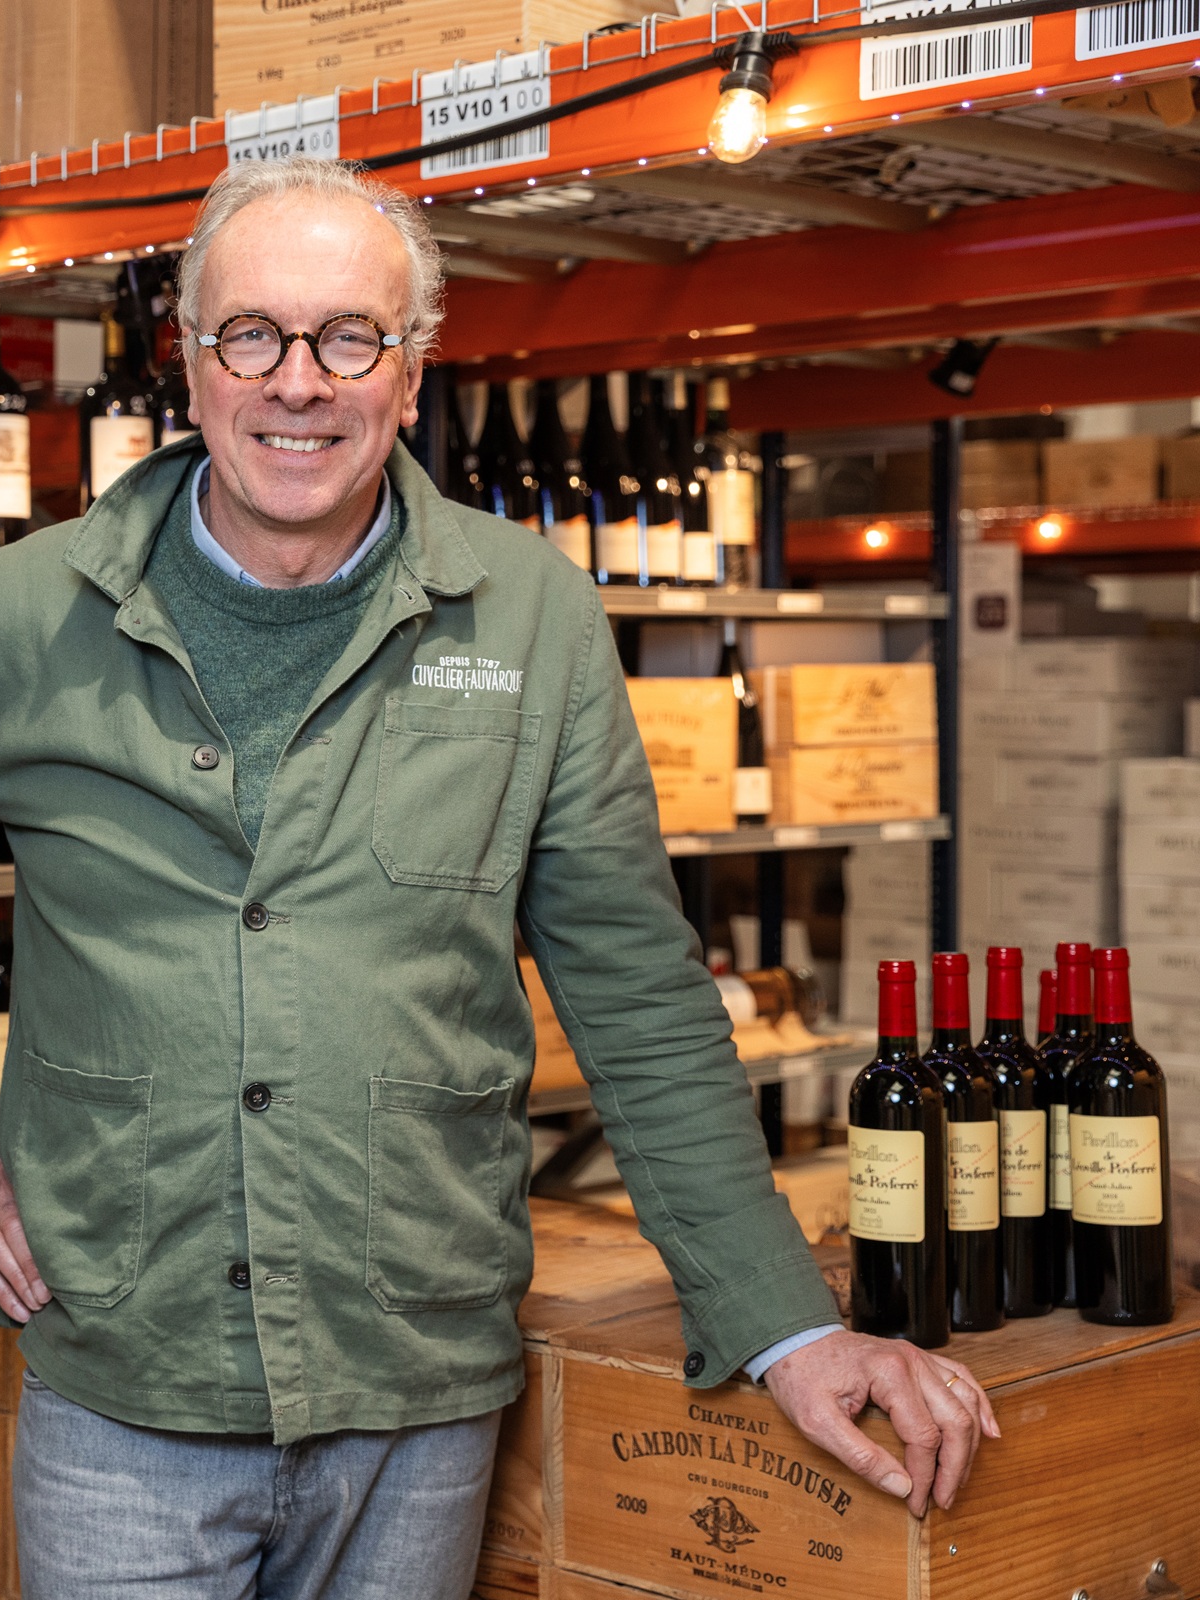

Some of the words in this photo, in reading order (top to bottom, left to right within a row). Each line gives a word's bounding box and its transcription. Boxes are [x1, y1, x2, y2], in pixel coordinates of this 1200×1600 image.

[428, 107, 449, 127] 15
[456, 99, 492, 121] V10
[500, 95, 508, 113] 1
[234, 148, 252, 161] 15
[258, 141, 291, 161] V10
[295, 137, 306, 152] 4
[439, 656, 470, 667] DEPUIS
[476, 657, 500, 670] 1787
[412, 665, 464, 690] CUVELIER
[465, 668, 524, 694] FAUVARQUE
[1016, 1145, 1029, 1156] de
[1081, 1130, 1139, 1149] Pavillon
[850, 1141, 899, 1163] Pavillon
[1103, 1150, 1115, 1161] de
[864, 1163, 876, 1175] de
[953, 1167, 996, 1184] Poyferré
[1109, 1160, 1157, 1179] Poyferré
[869, 1174, 919, 1193] Poyferré
[688, 1404, 770, 1436] CHATEAU
[612, 1431, 703, 1463] CAMBON
[708, 1435, 736, 1464] LA
[742, 1437, 852, 1518] PELOUSE
[687, 1472, 709, 1486] CRU
[711, 1478, 770, 1500] BOURGEOIS
[615, 1493, 648, 1515] 2009
[807, 1538, 843, 1563] 2009
[670, 1547, 787, 1588] HAUT-MÉDOC
